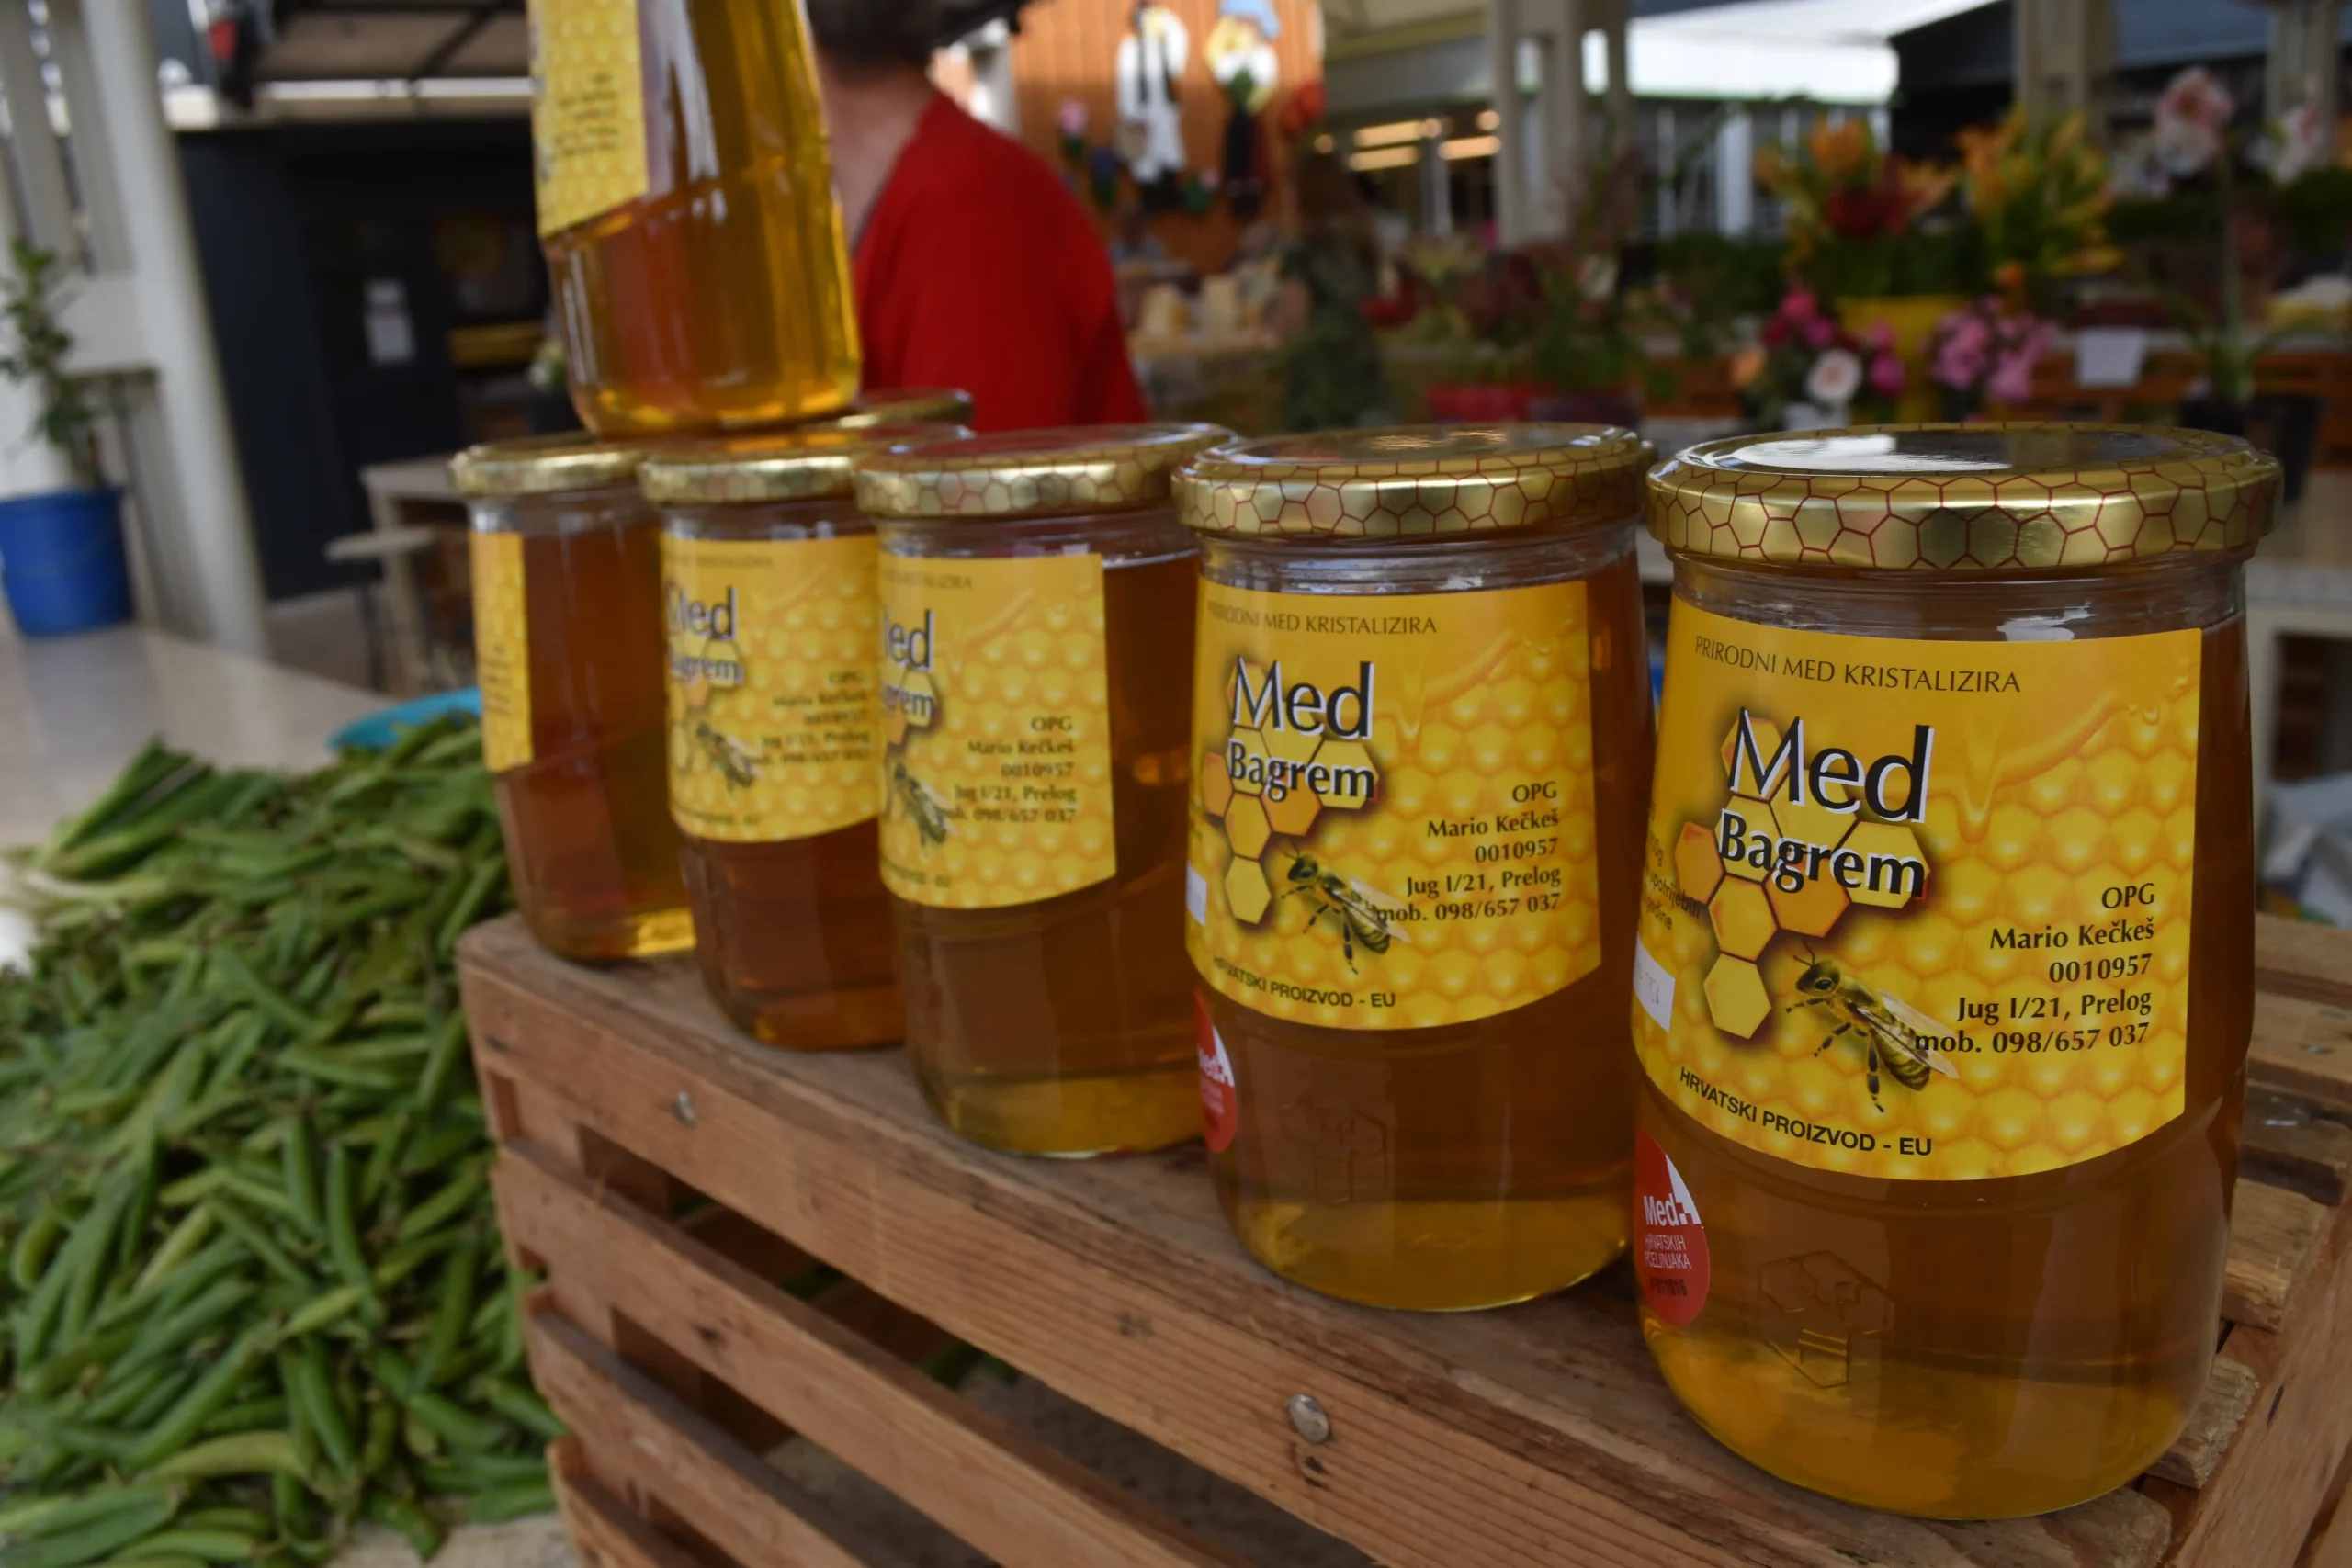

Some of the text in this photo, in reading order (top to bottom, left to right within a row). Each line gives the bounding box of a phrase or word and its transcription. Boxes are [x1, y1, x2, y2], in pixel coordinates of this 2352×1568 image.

[1262, 614, 1301, 632] MED
[1306, 616, 1438, 636] KRISTALIZIRA
[1694, 635, 2021, 694] PRIRODNI MED KRISTALIZIRA
[1232, 655, 1375, 740] Med
[1031, 716, 1072, 732] OPG
[1227, 738, 1375, 803] Bagrem
[1728, 706, 1935, 823] Med
[1023, 784, 1078, 804] Prelog
[1511, 781, 1557, 804] OPG
[1427, 808, 1559, 839] Mario Kečkeš
[1475, 837, 1559, 863] 0010957
[1717, 809, 1926, 897] Bagrem
[1407, 868, 1562, 900] Jug I/21, Prelog
[2100, 883, 2155, 911] OPG
[1375, 892, 1561, 924] mob. 098/657 037
[1989, 916, 2155, 950] Mario Kečkeš
[2050, 953, 2153, 984] 0010957
[1270, 980, 1354, 1008] PROIZVOD
[1371, 993, 1396, 1008] EU
[1956, 989, 2153, 1026] Jug I/21, Prelog
[1914, 1021, 2150, 1054] mob. 098/657 037
[1679, 1066, 1758, 1122] HRVATSKI
[1761, 1110, 1876, 1152] PROIZVOD
[1899, 1137, 1933, 1156] EU
[1643, 1193, 1680, 1227] Med
